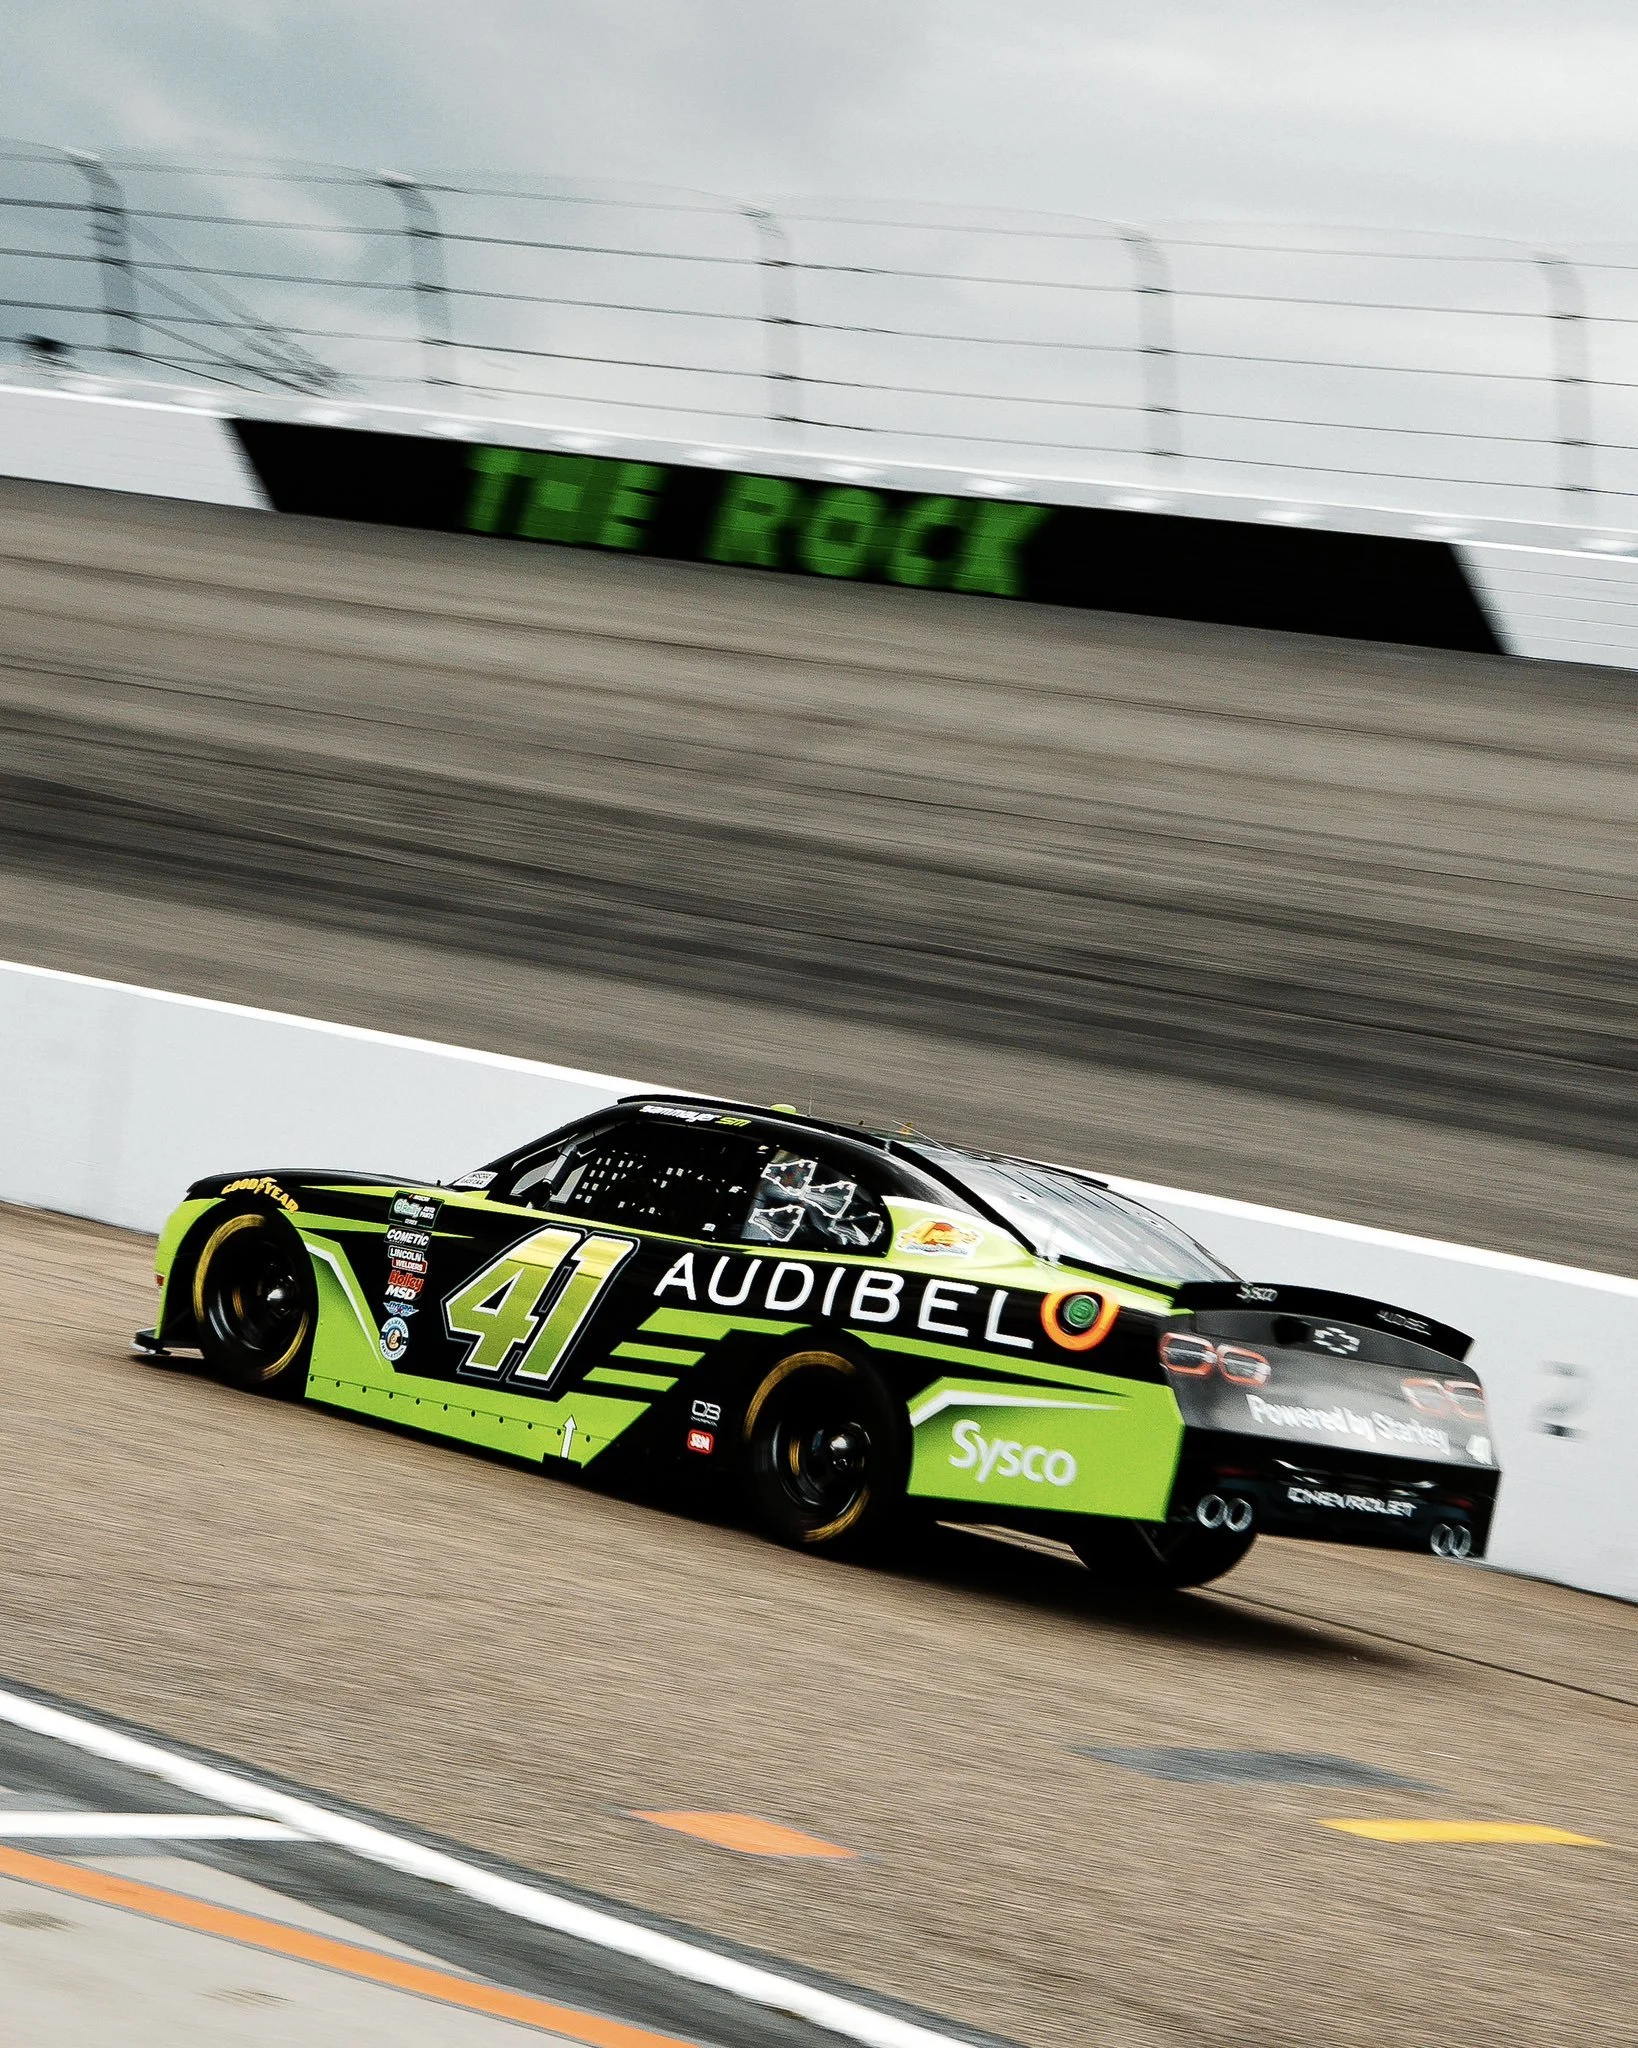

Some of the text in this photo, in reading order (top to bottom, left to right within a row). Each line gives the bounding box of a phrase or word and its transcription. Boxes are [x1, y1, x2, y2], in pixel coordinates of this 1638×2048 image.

[462, 446, 1054, 598] THE ROCK
[221, 1177, 299, 1214] GOODYEAR
[386, 1229, 430, 1246] COMETIC
[389, 1247, 423, 1261] LINCOLN
[388, 1269, 424, 1293] Holley
[395, 1259, 424, 1271] WELDERS
[384, 1285, 416, 1300] MSD
[444, 1228, 636, 1382] 41
[653, 1251, 1035, 1350] AUDIBEL
[1246, 1393, 1451, 1456] Powered by Starkey
[950, 1419, 1078, 1486] Sysco
[1286, 1486, 1417, 1518] CHEVROLET
